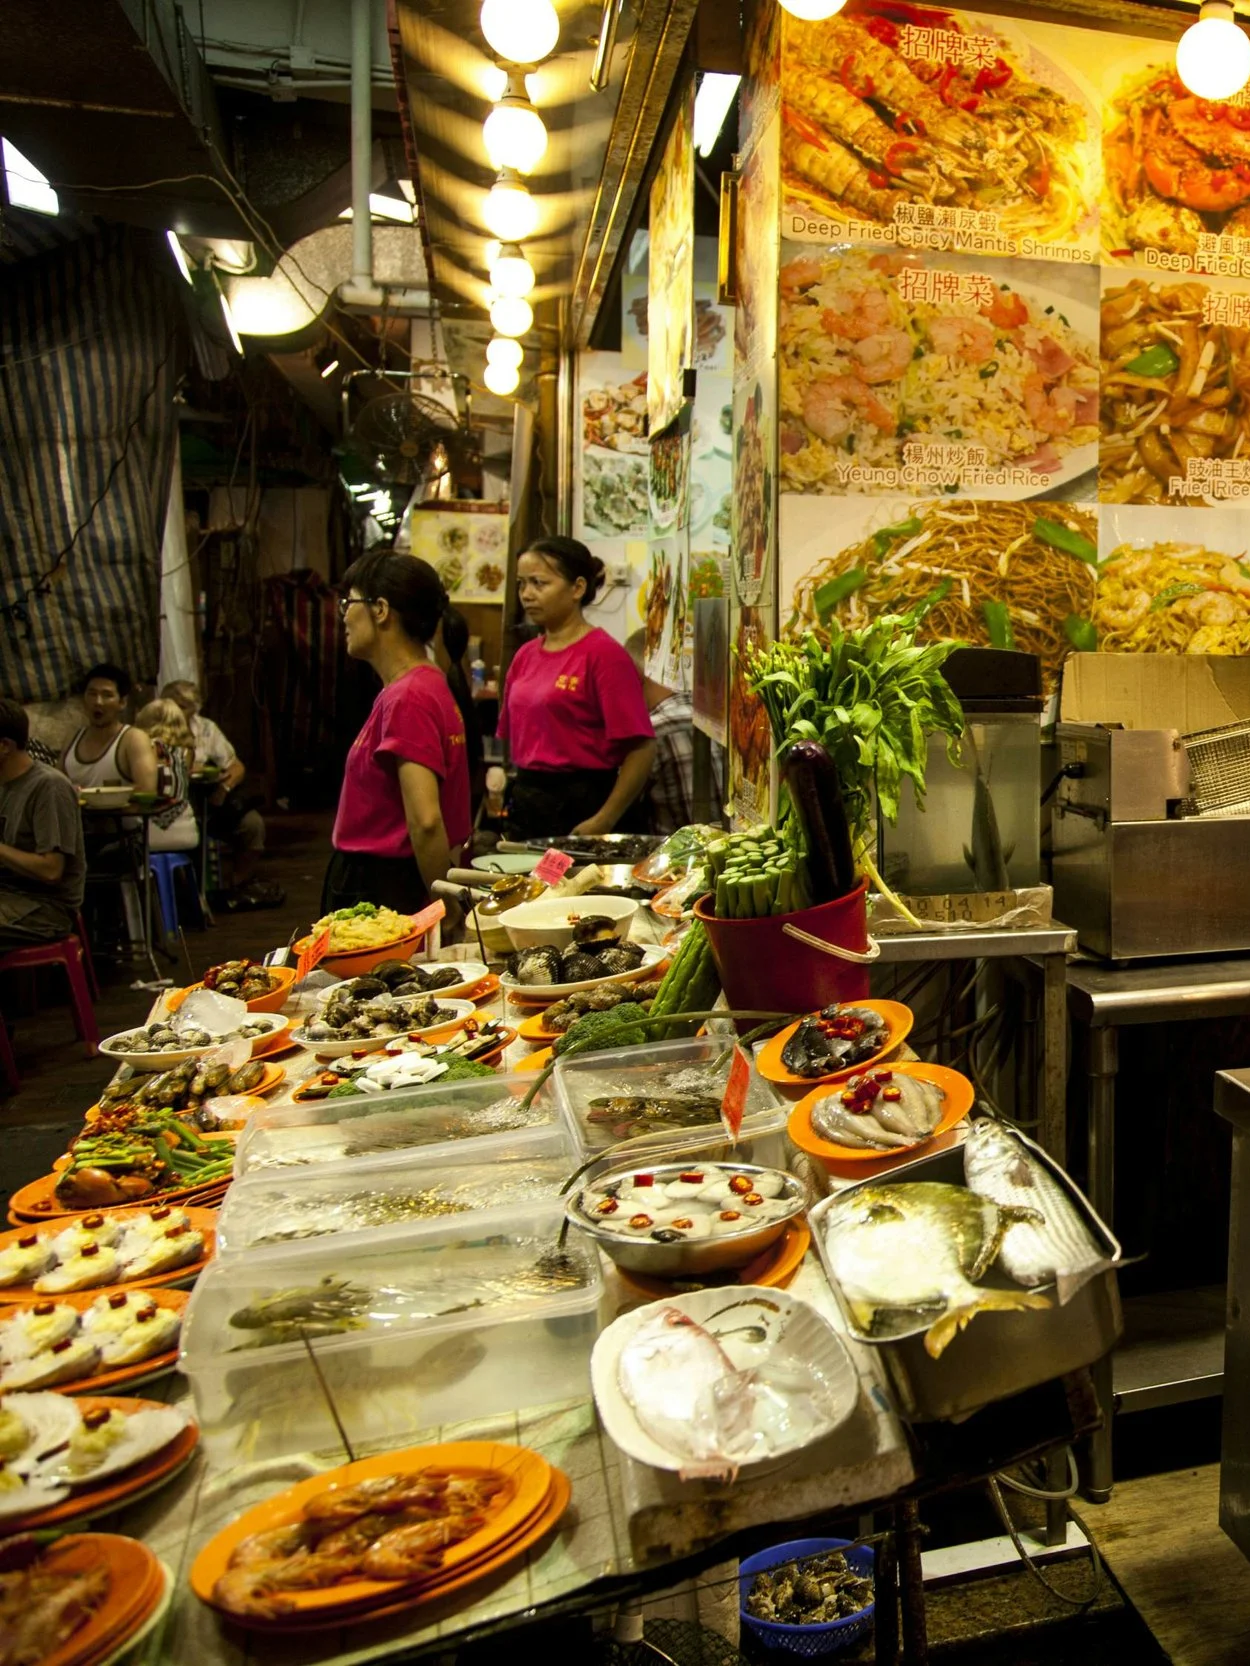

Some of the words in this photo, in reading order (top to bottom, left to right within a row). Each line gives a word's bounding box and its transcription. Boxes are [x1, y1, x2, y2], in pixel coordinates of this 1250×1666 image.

[903, 27, 995, 67] 招牌菜
[895, 205, 997, 232] 椒鹽瀨尿蝦
[791, 216, 841, 239] Deep
[848, 221, 895, 241] Fried
[901, 226, 948, 249] Spicy
[956, 232, 1016, 253] Mantis
[1021, 239, 1092, 262] Shrimps
[1146, 249, 1191, 271] Deep
[1197, 255, 1238, 275] Fried
[901, 269, 991, 305] 招牌菜
[837, 465, 896, 484] Yeung
[902, 466, 956, 484] Chow
[962, 469, 1006, 486] Fried
[1012, 471, 1050, 487] Rice
[1170, 479, 1211, 495] Fried
[1216, 481, 1249, 497] Rice
